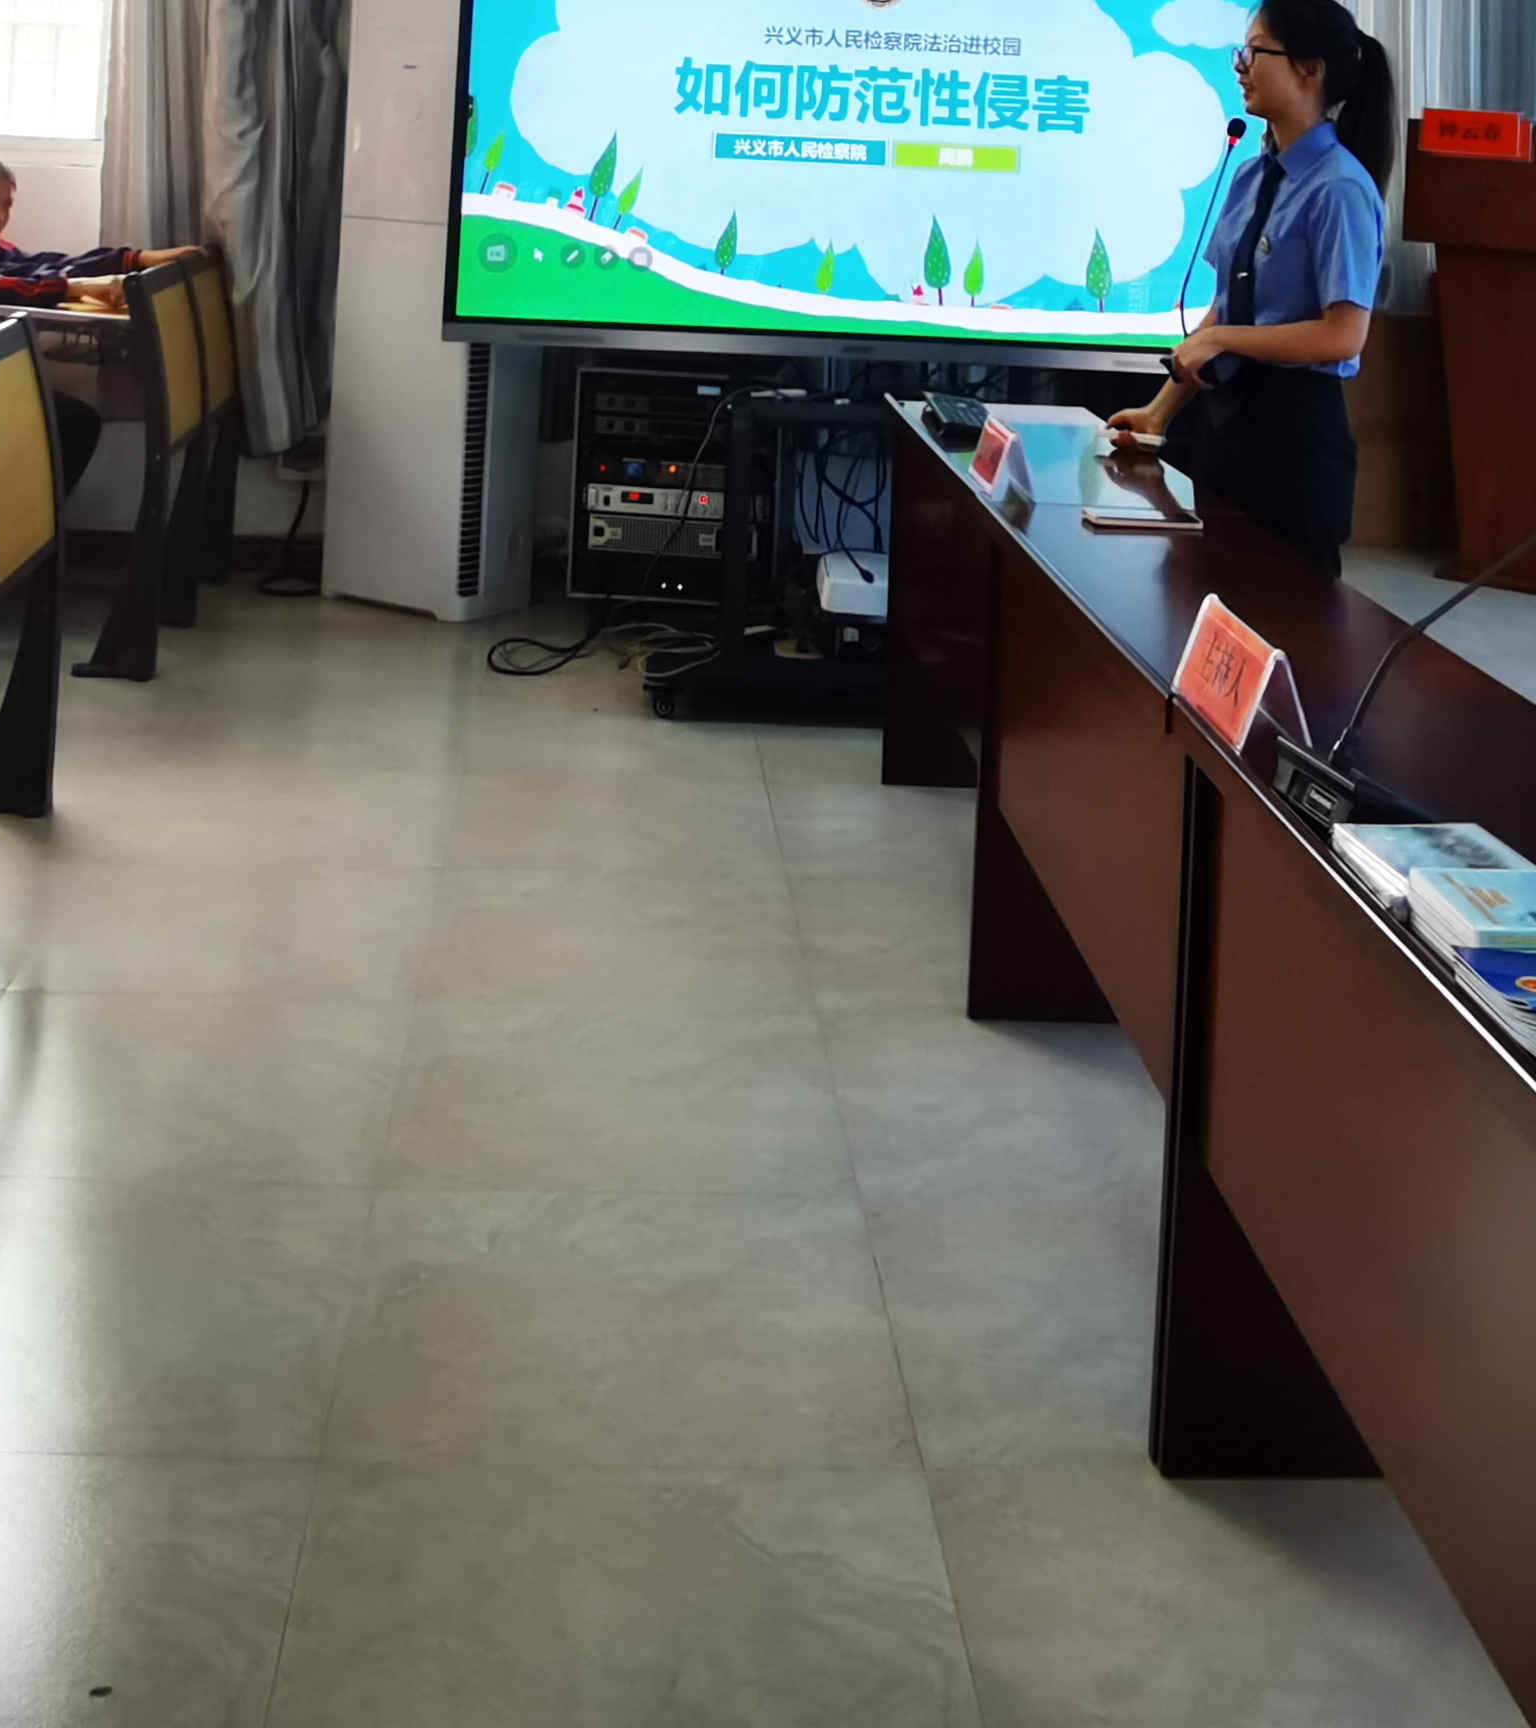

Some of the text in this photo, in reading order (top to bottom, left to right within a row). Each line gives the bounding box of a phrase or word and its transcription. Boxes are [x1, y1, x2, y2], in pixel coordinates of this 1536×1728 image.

[764, 25, 1022, 57] 兴义市人民检察院法治进校园
[674, 56, 1091, 135] 如何防范性侵害
[733, 138, 868, 162] 兴义市人民检察院
